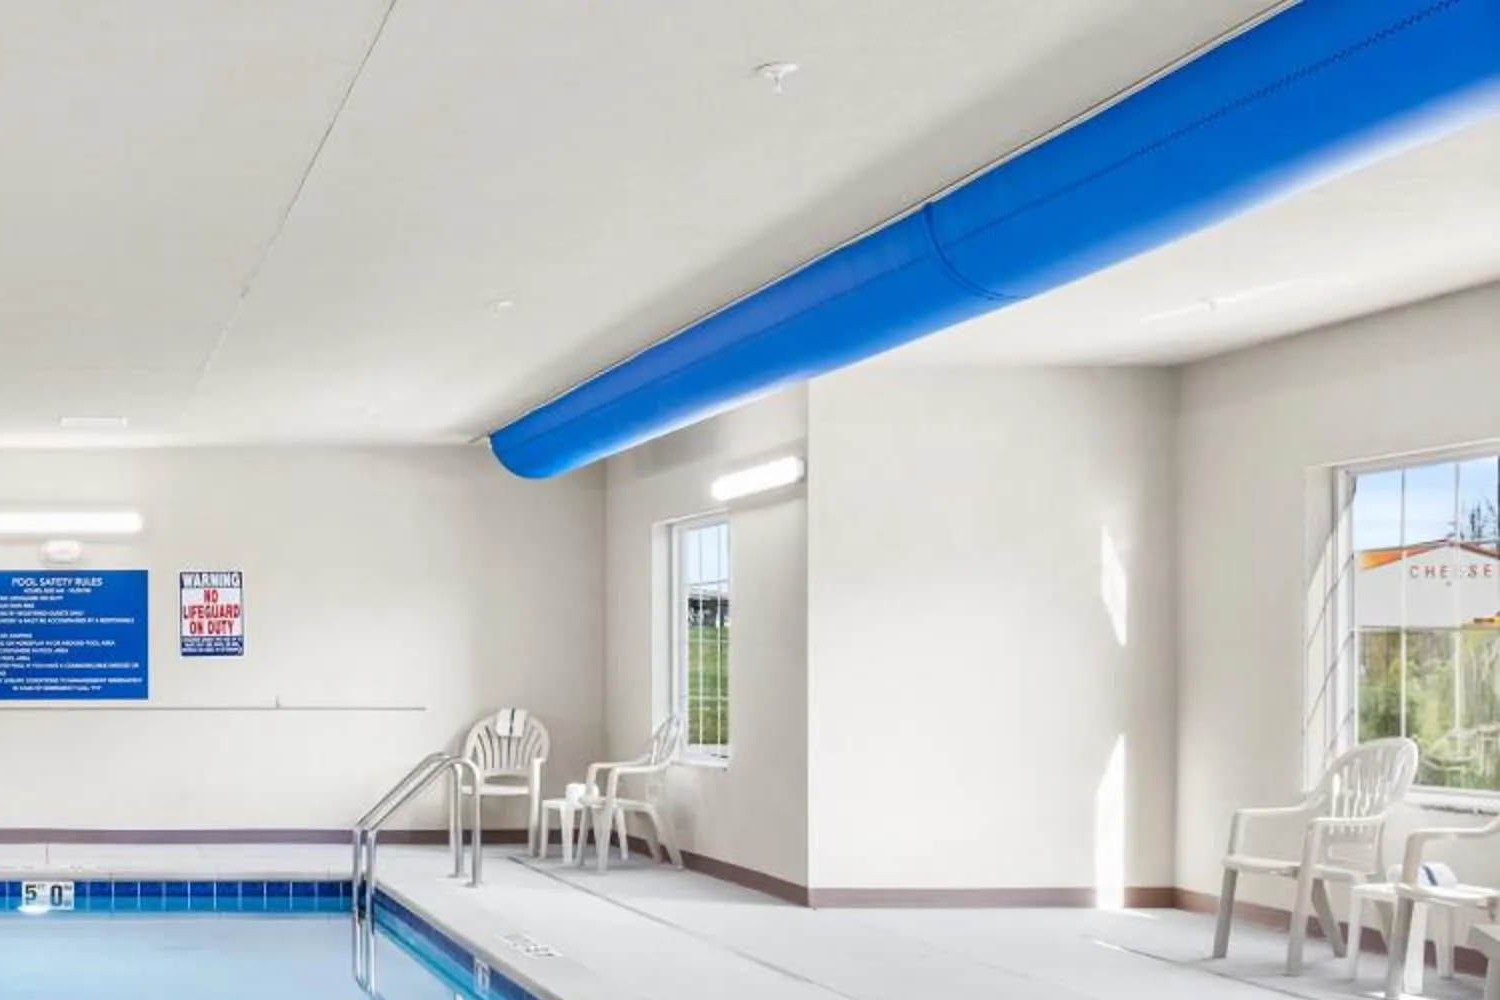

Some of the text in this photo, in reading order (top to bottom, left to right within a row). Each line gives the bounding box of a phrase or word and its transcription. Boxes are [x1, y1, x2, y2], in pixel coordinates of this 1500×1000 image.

[1409, 563, 1493, 579] CHESE
[11, 577, 103, 587] POOL SAFETY RULES
[182, 573, 240, 587] WARNING
[203, 589, 219, 603] NO
[183, 604, 241, 619] LIFEGUARD
[189, 620, 234, 634] ON DUTY
[25, 884, 37, 900] 5
[50, 884, 63, 906] 0
